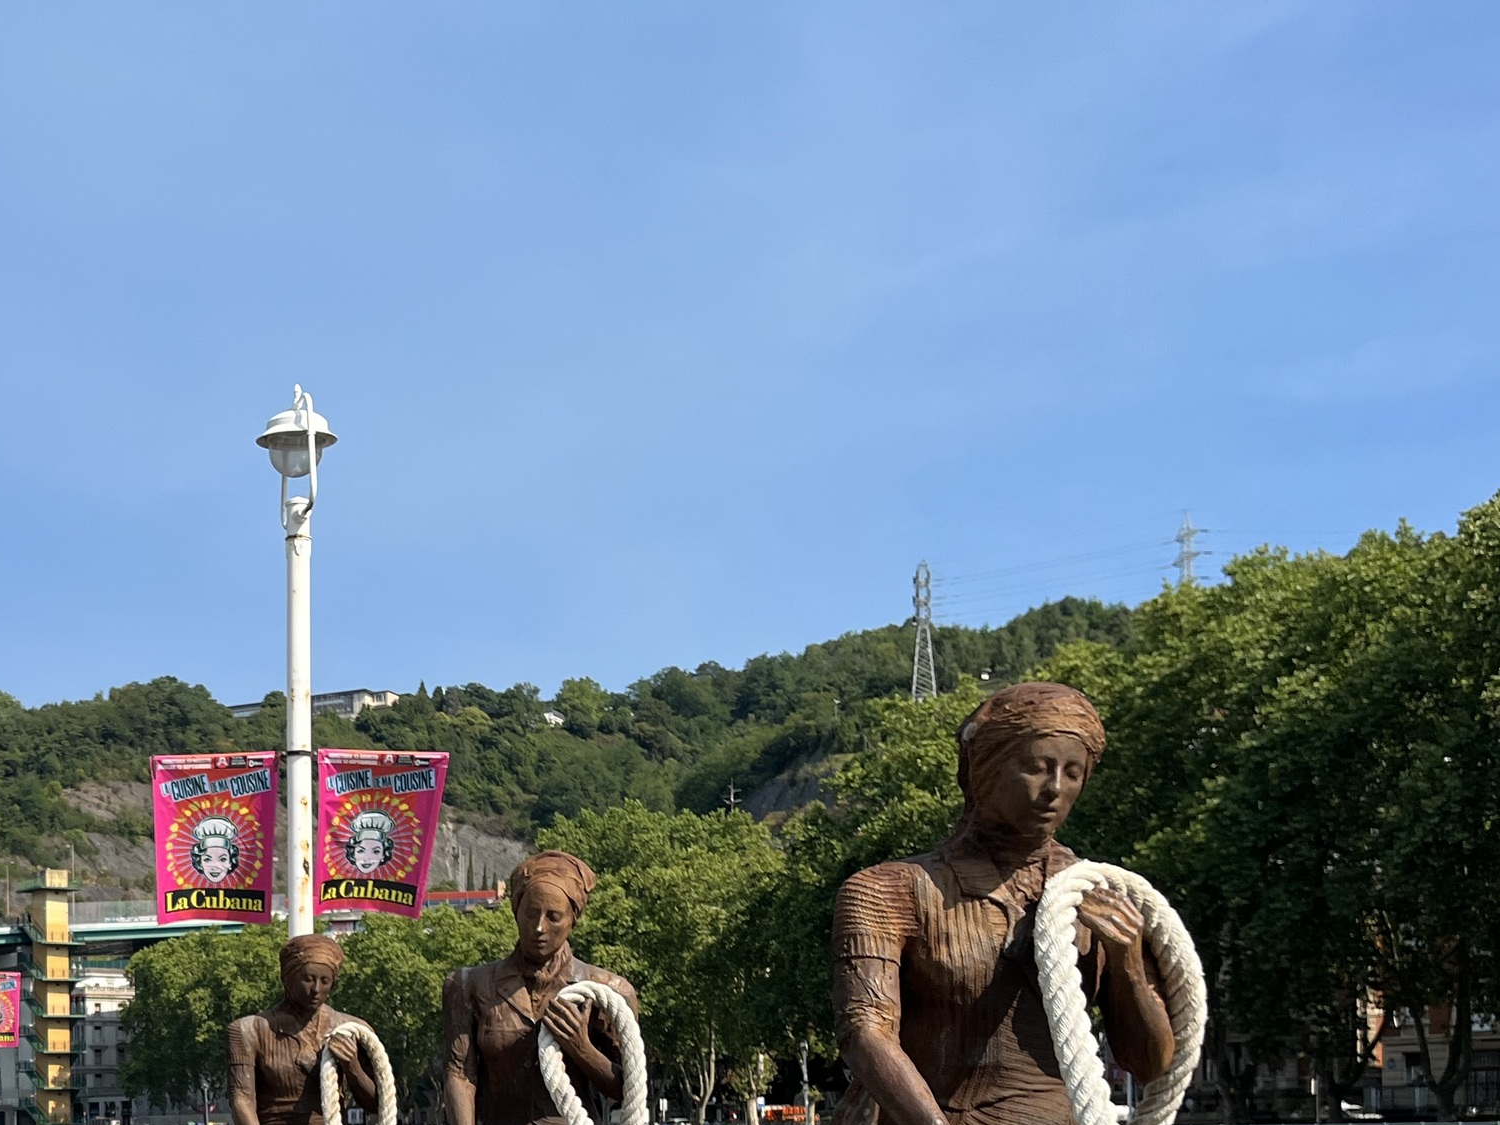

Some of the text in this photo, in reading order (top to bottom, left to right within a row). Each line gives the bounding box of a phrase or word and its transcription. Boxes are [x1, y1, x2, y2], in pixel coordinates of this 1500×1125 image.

[171, 775, 209, 800] CUISINE
[230, 770, 270, 797] COUSINE
[335, 769, 372, 795] CUISINE
[394, 769, 434, 793] COUSINE
[166, 889, 263, 912] La Cubana
[321, 880, 414, 906] La Cubana
